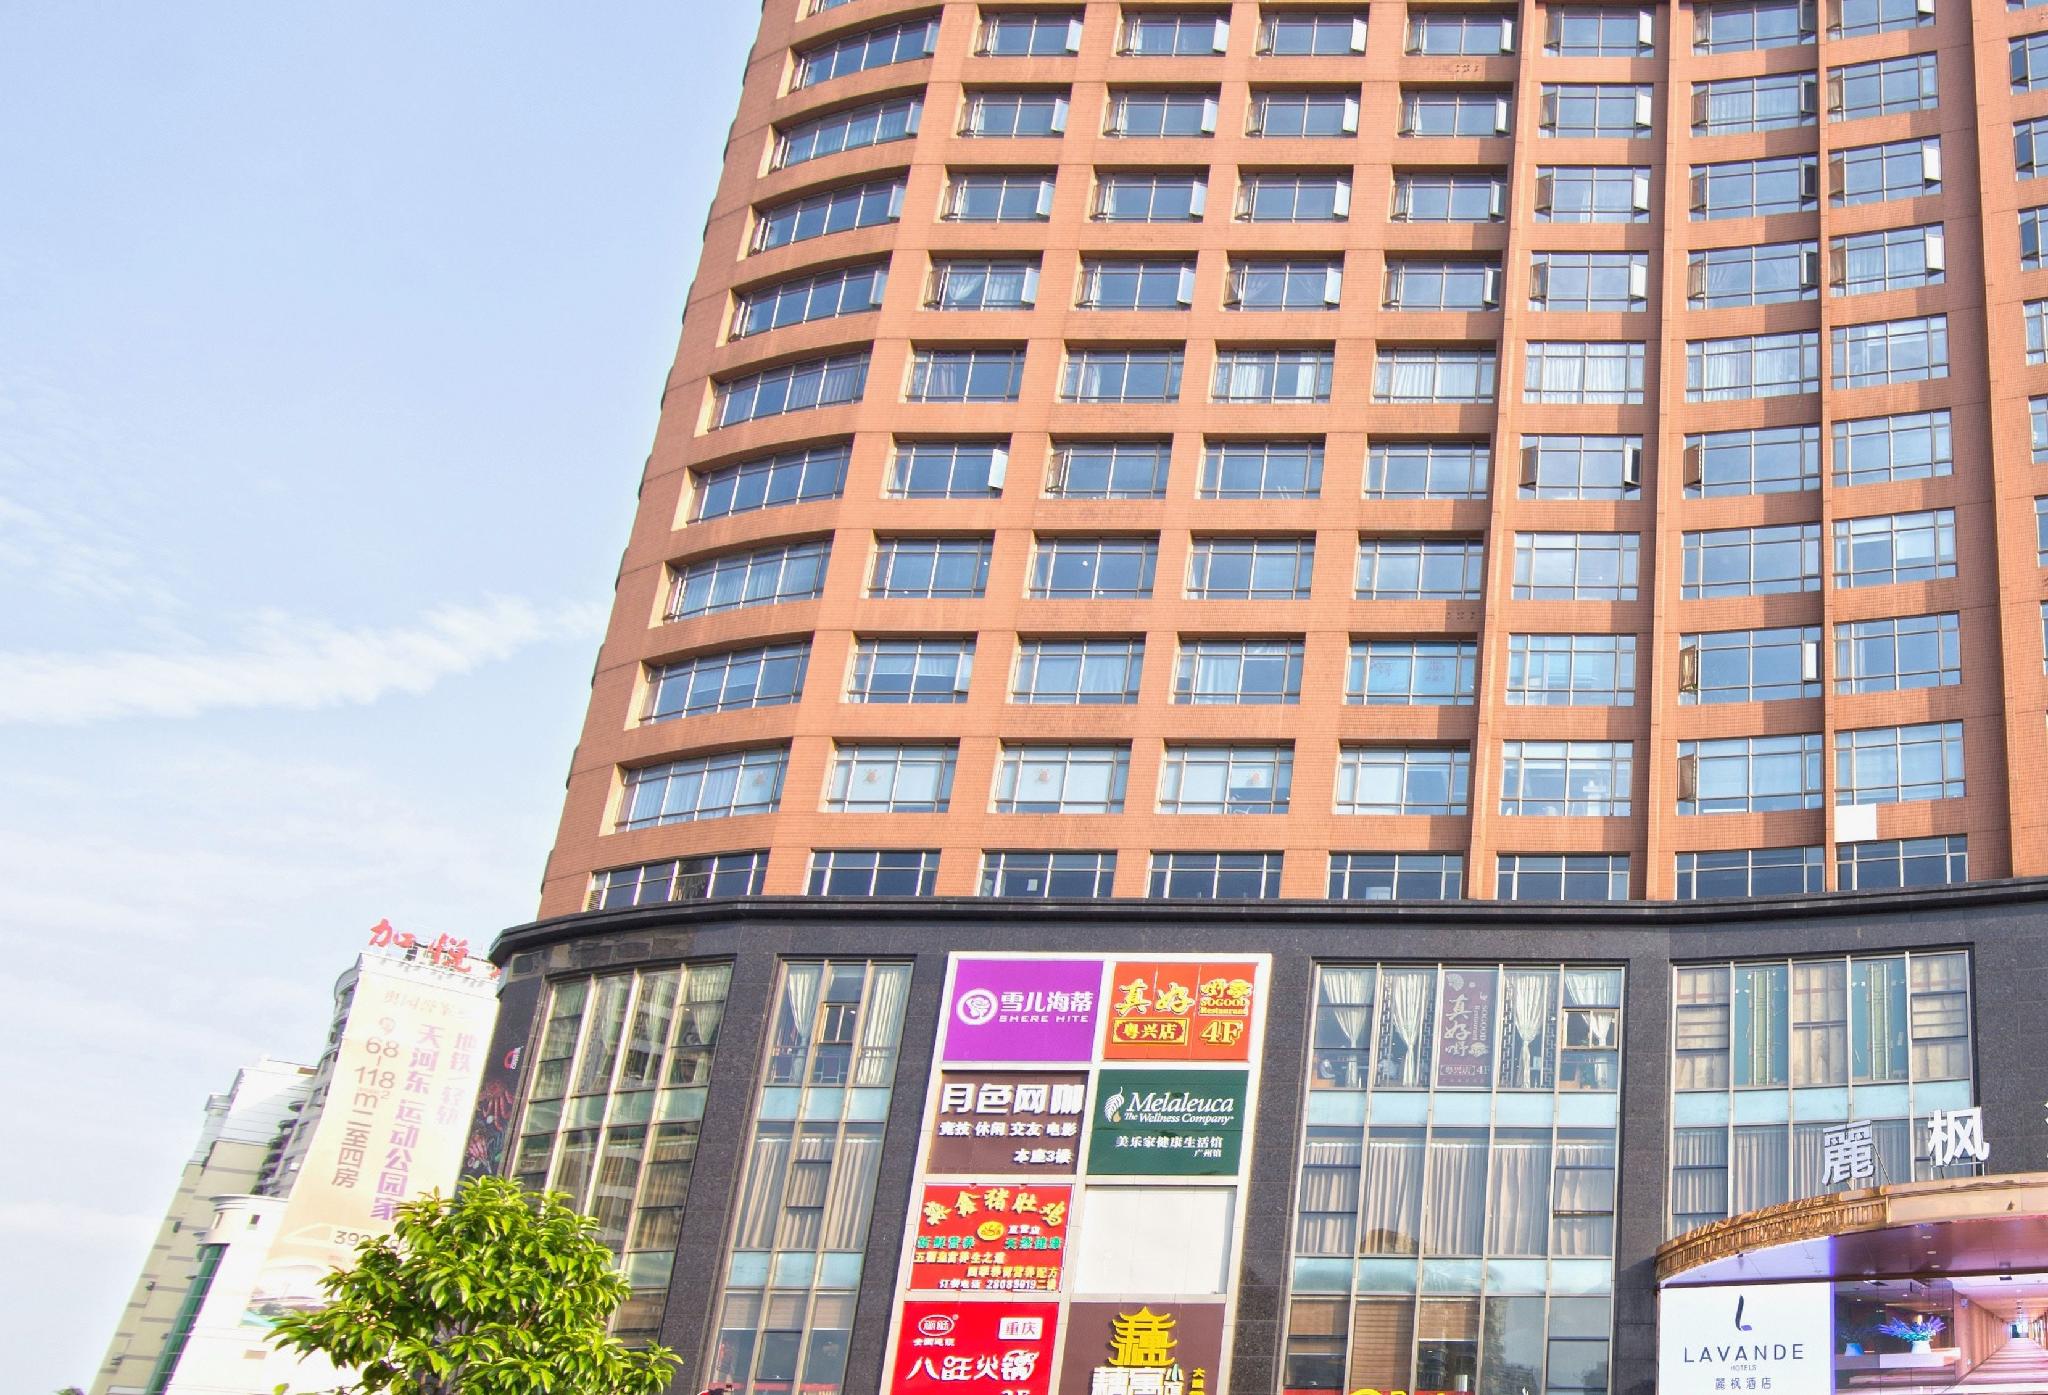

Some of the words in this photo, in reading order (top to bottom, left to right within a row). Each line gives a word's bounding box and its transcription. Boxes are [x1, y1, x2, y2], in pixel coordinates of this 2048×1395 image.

[369, 918, 501, 977] 加悦
[1000, 991, 1093, 1013] 雪儿海蒂
[1199, 998, 1250, 1007] SOGOOD
[999, 1015, 1045, 1023] SHERE
[1055, 1015, 1088, 1023] HITE
[1122, 1022, 1178, 1040] 粤兴店
[1201, 1020, 1244, 1046] 4F
[941, 1083, 1086, 1115] 月色网咖
[1126, 1091, 1234, 1113] Melaleuca
[1124, 1112, 1138, 1121] The
[1140, 1112, 1181, 1123] Wellness
[1181, 1113, 1231, 1126] Company
[1009, 1121, 1043, 1137] 交友
[1046, 1121, 1078, 1137] 电影
[1115, 1135, 1224, 1149] 美乐家健康生活馆
[1192, 1148, 1222, 1158] 广州馆
[1006, 1321, 1037, 1336] 重庆
[1684, 1343, 1804, 1363] LAVANDE
[1730, 1364, 1757, 1372] HOTELS
